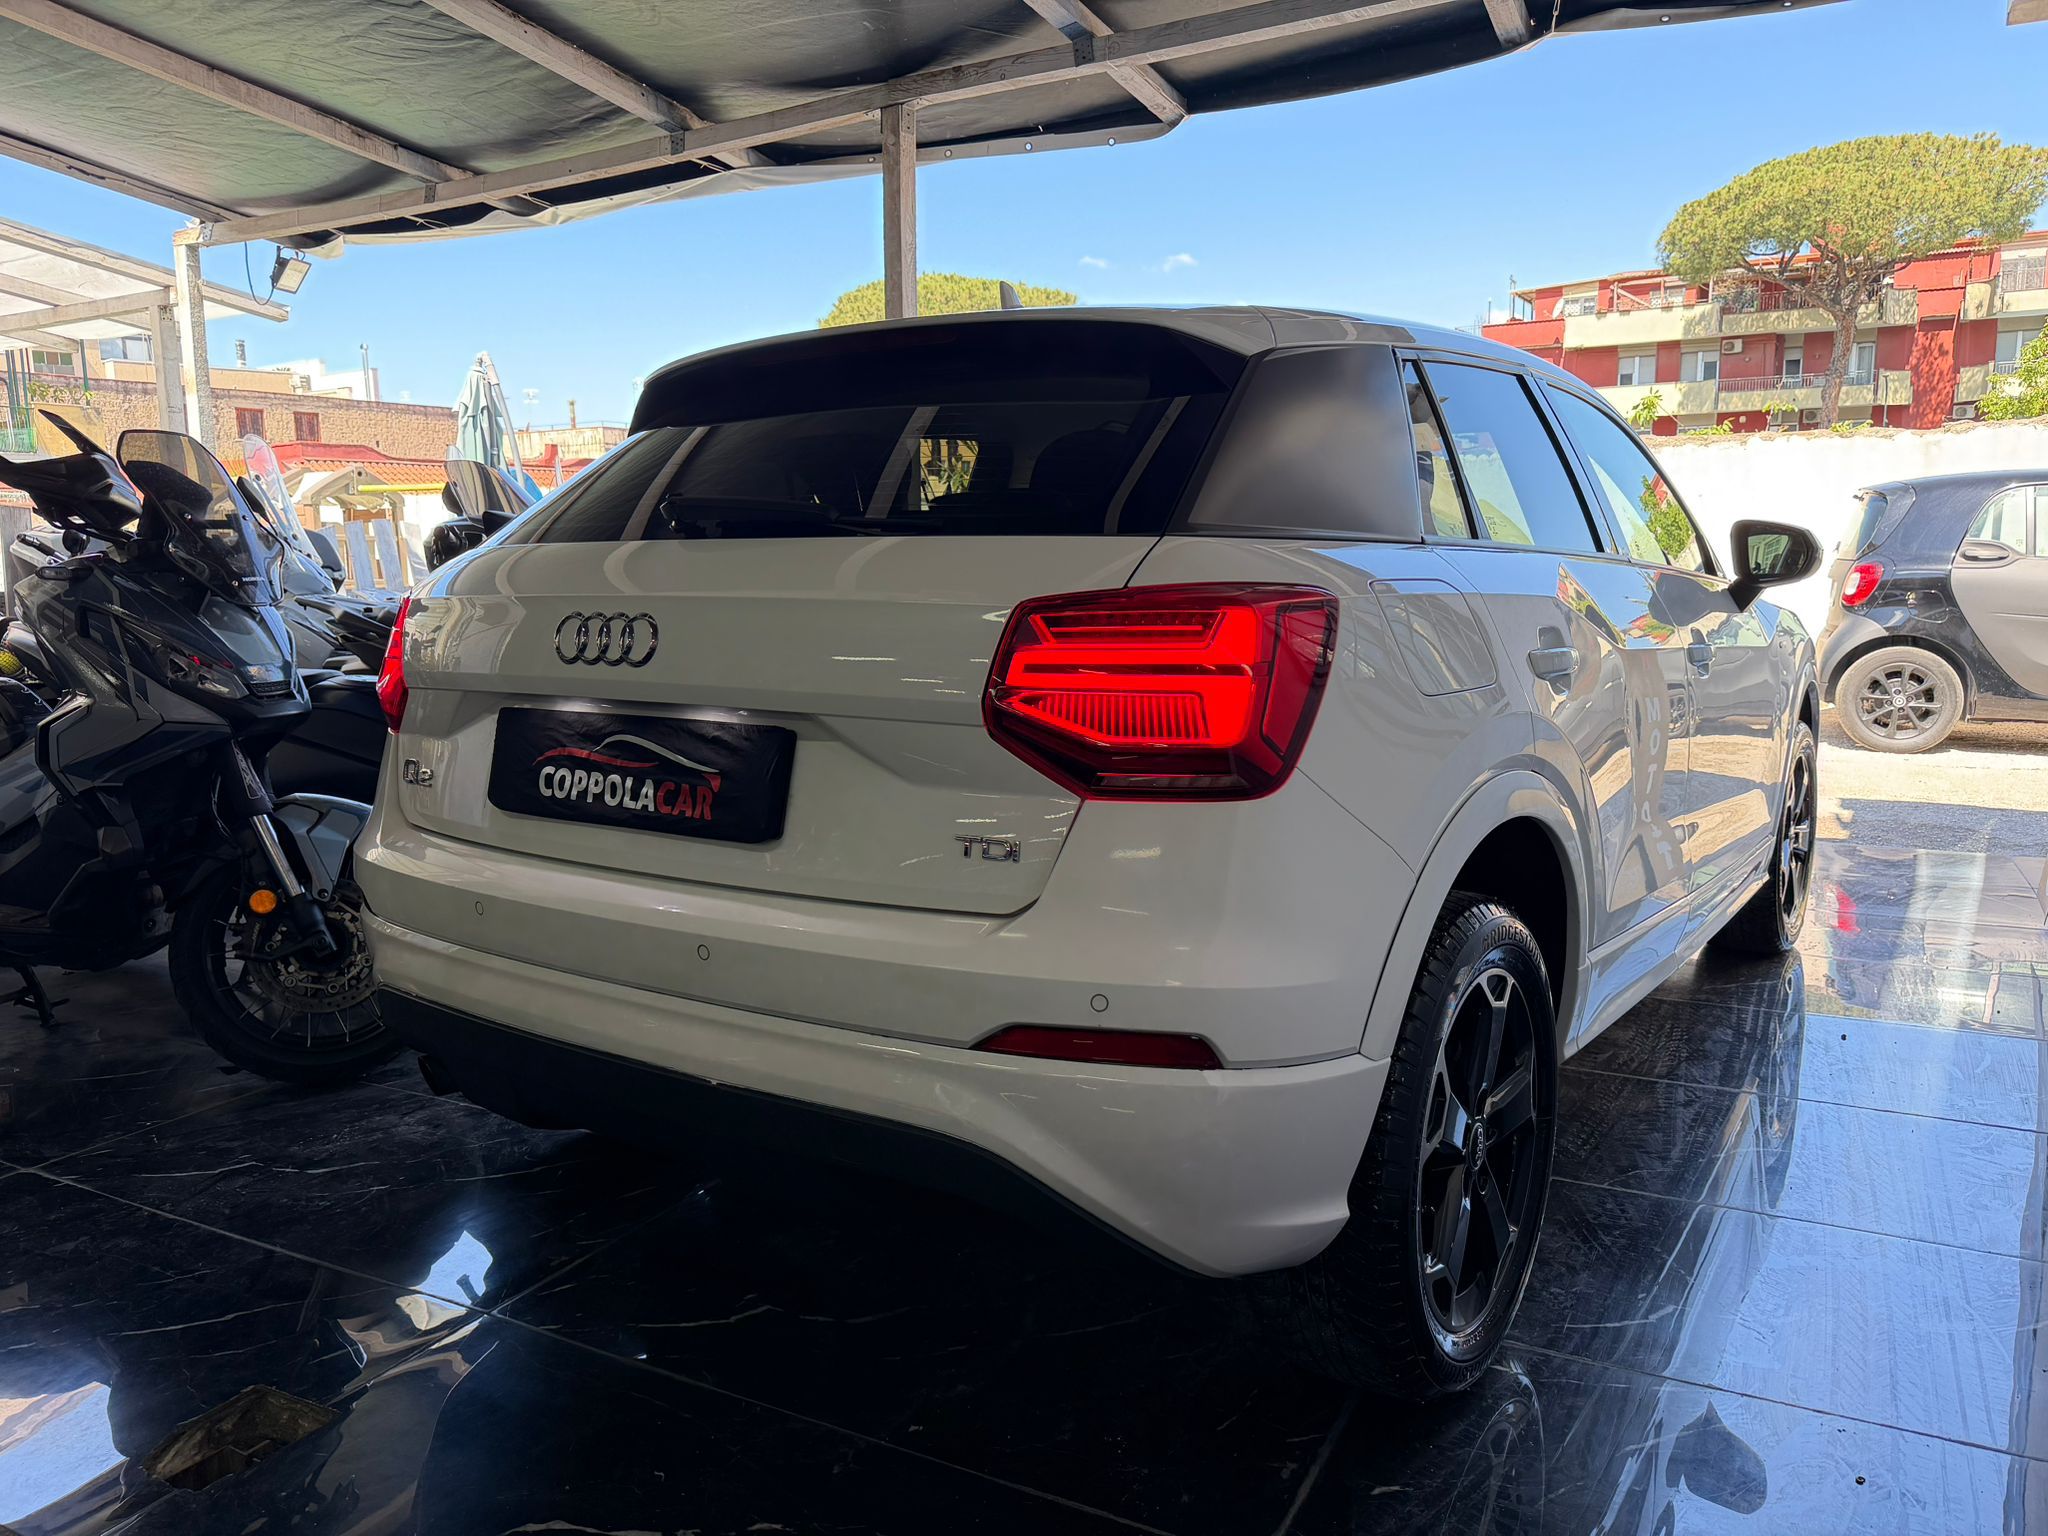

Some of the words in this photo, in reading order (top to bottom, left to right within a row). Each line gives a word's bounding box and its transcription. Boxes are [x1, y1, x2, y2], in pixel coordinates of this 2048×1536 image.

[402, 758, 433, 788] Q2
[539, 766, 713, 821] COPPOLACAR
[954, 834, 1021, 863] TDI
